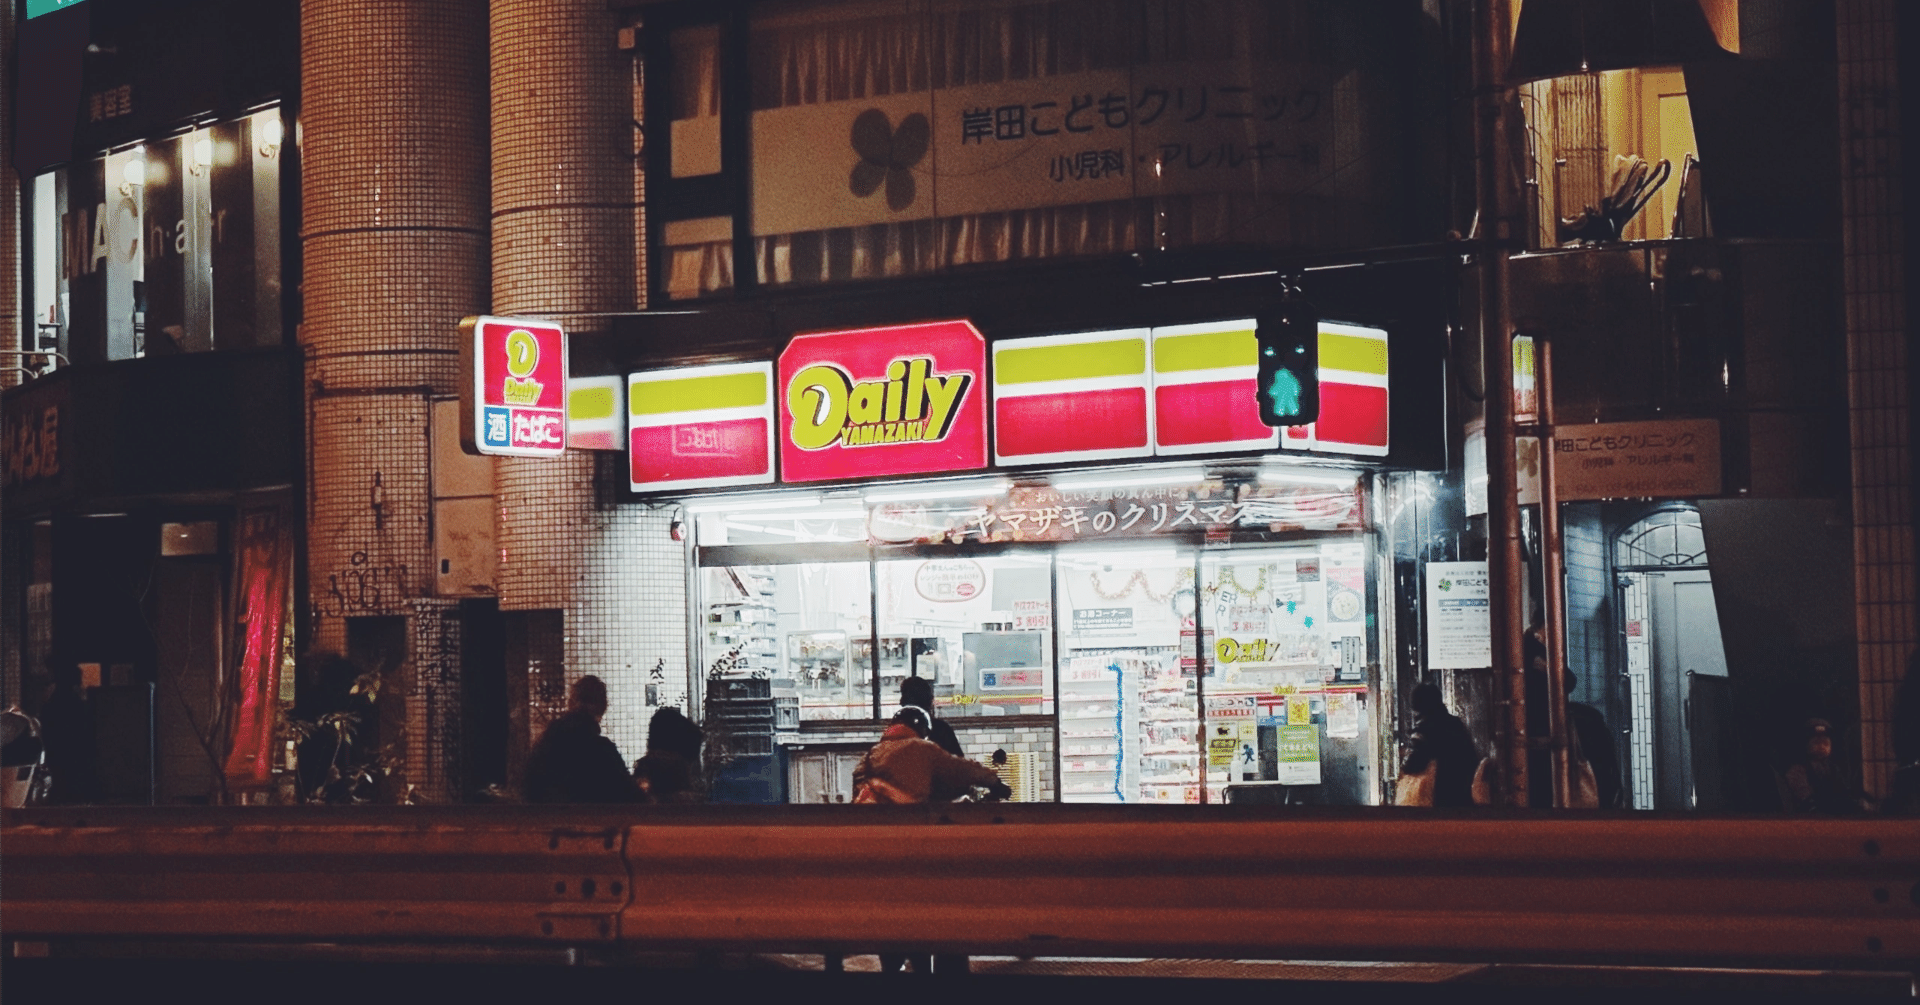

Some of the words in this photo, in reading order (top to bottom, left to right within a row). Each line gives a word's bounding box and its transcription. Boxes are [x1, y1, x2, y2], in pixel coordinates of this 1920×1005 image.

[961, 88, 1322, 145] 岸田こどもクリニック
[790, 357, 971, 450] Daily
[488, 412, 507, 442] 酒
[513, 413, 561, 444] たばこ
[841, 420, 925, 447] YAMAZAKI
[968, 502, 1246, 537] ヤマザキのクリスマス
[1216, 637, 1280, 664] Daily
